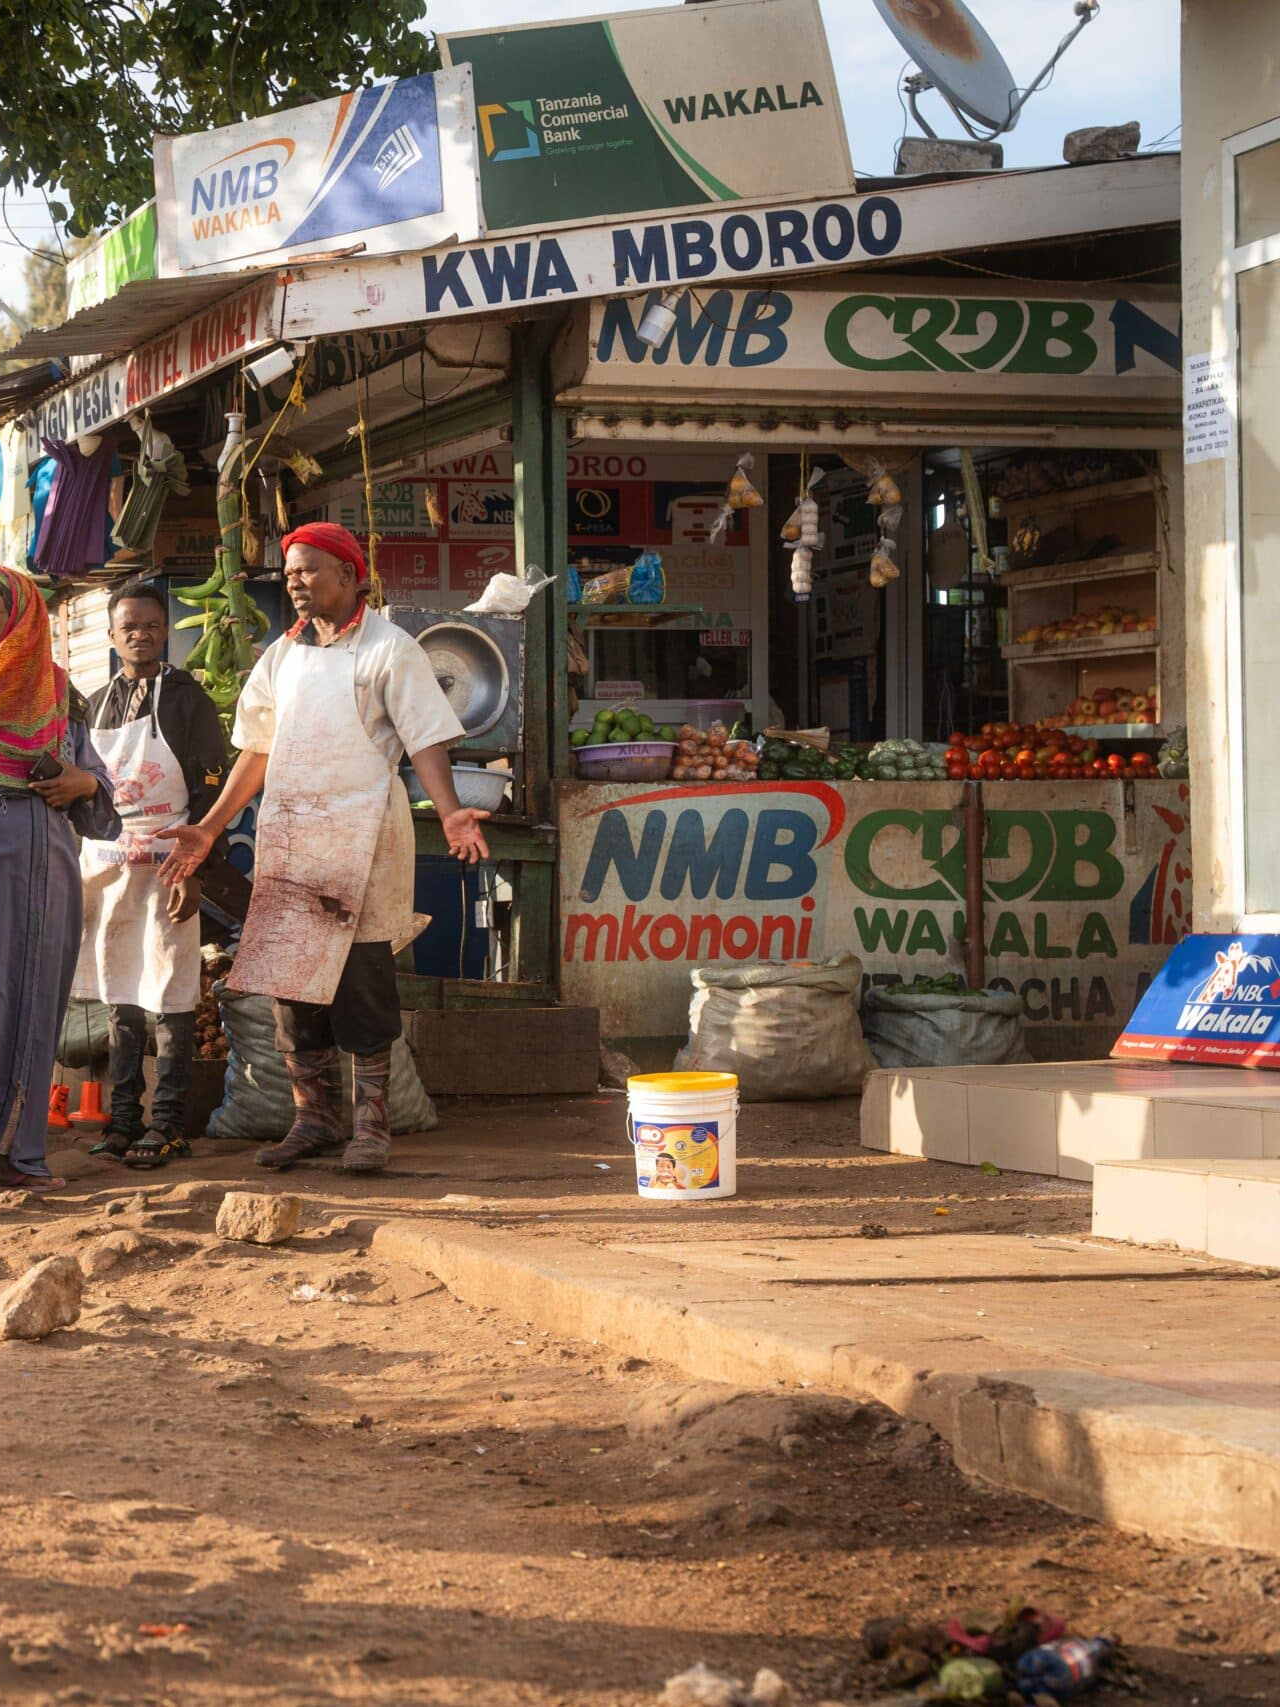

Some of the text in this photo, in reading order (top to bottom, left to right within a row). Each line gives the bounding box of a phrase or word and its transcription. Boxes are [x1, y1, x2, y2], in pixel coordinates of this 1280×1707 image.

[536, 92, 602, 113] Tanzania
[540, 104, 629, 128] Commercial
[664, 81, 824, 124] WAKALA
[543, 127, 581, 144] Bank
[191, 159, 279, 216] NMB
[191, 201, 282, 241] WAKALA
[422, 196, 903, 314] KWA MBOROO
[596, 289, 794, 368] NMB
[824, 294, 1098, 375] CRDB
[36, 396, 68, 453] TIGO
[73, 370, 112, 433] PESA
[126, 333, 183, 409] AIRTEL
[189, 284, 265, 373] MONEY
[494, 511, 514, 522] NB
[579, 808, 818, 903] NMB
[563, 896, 816, 962] mkononi
[1231, 984, 1270, 1002] NBC
[1175, 1005, 1273, 1035] Wakala
